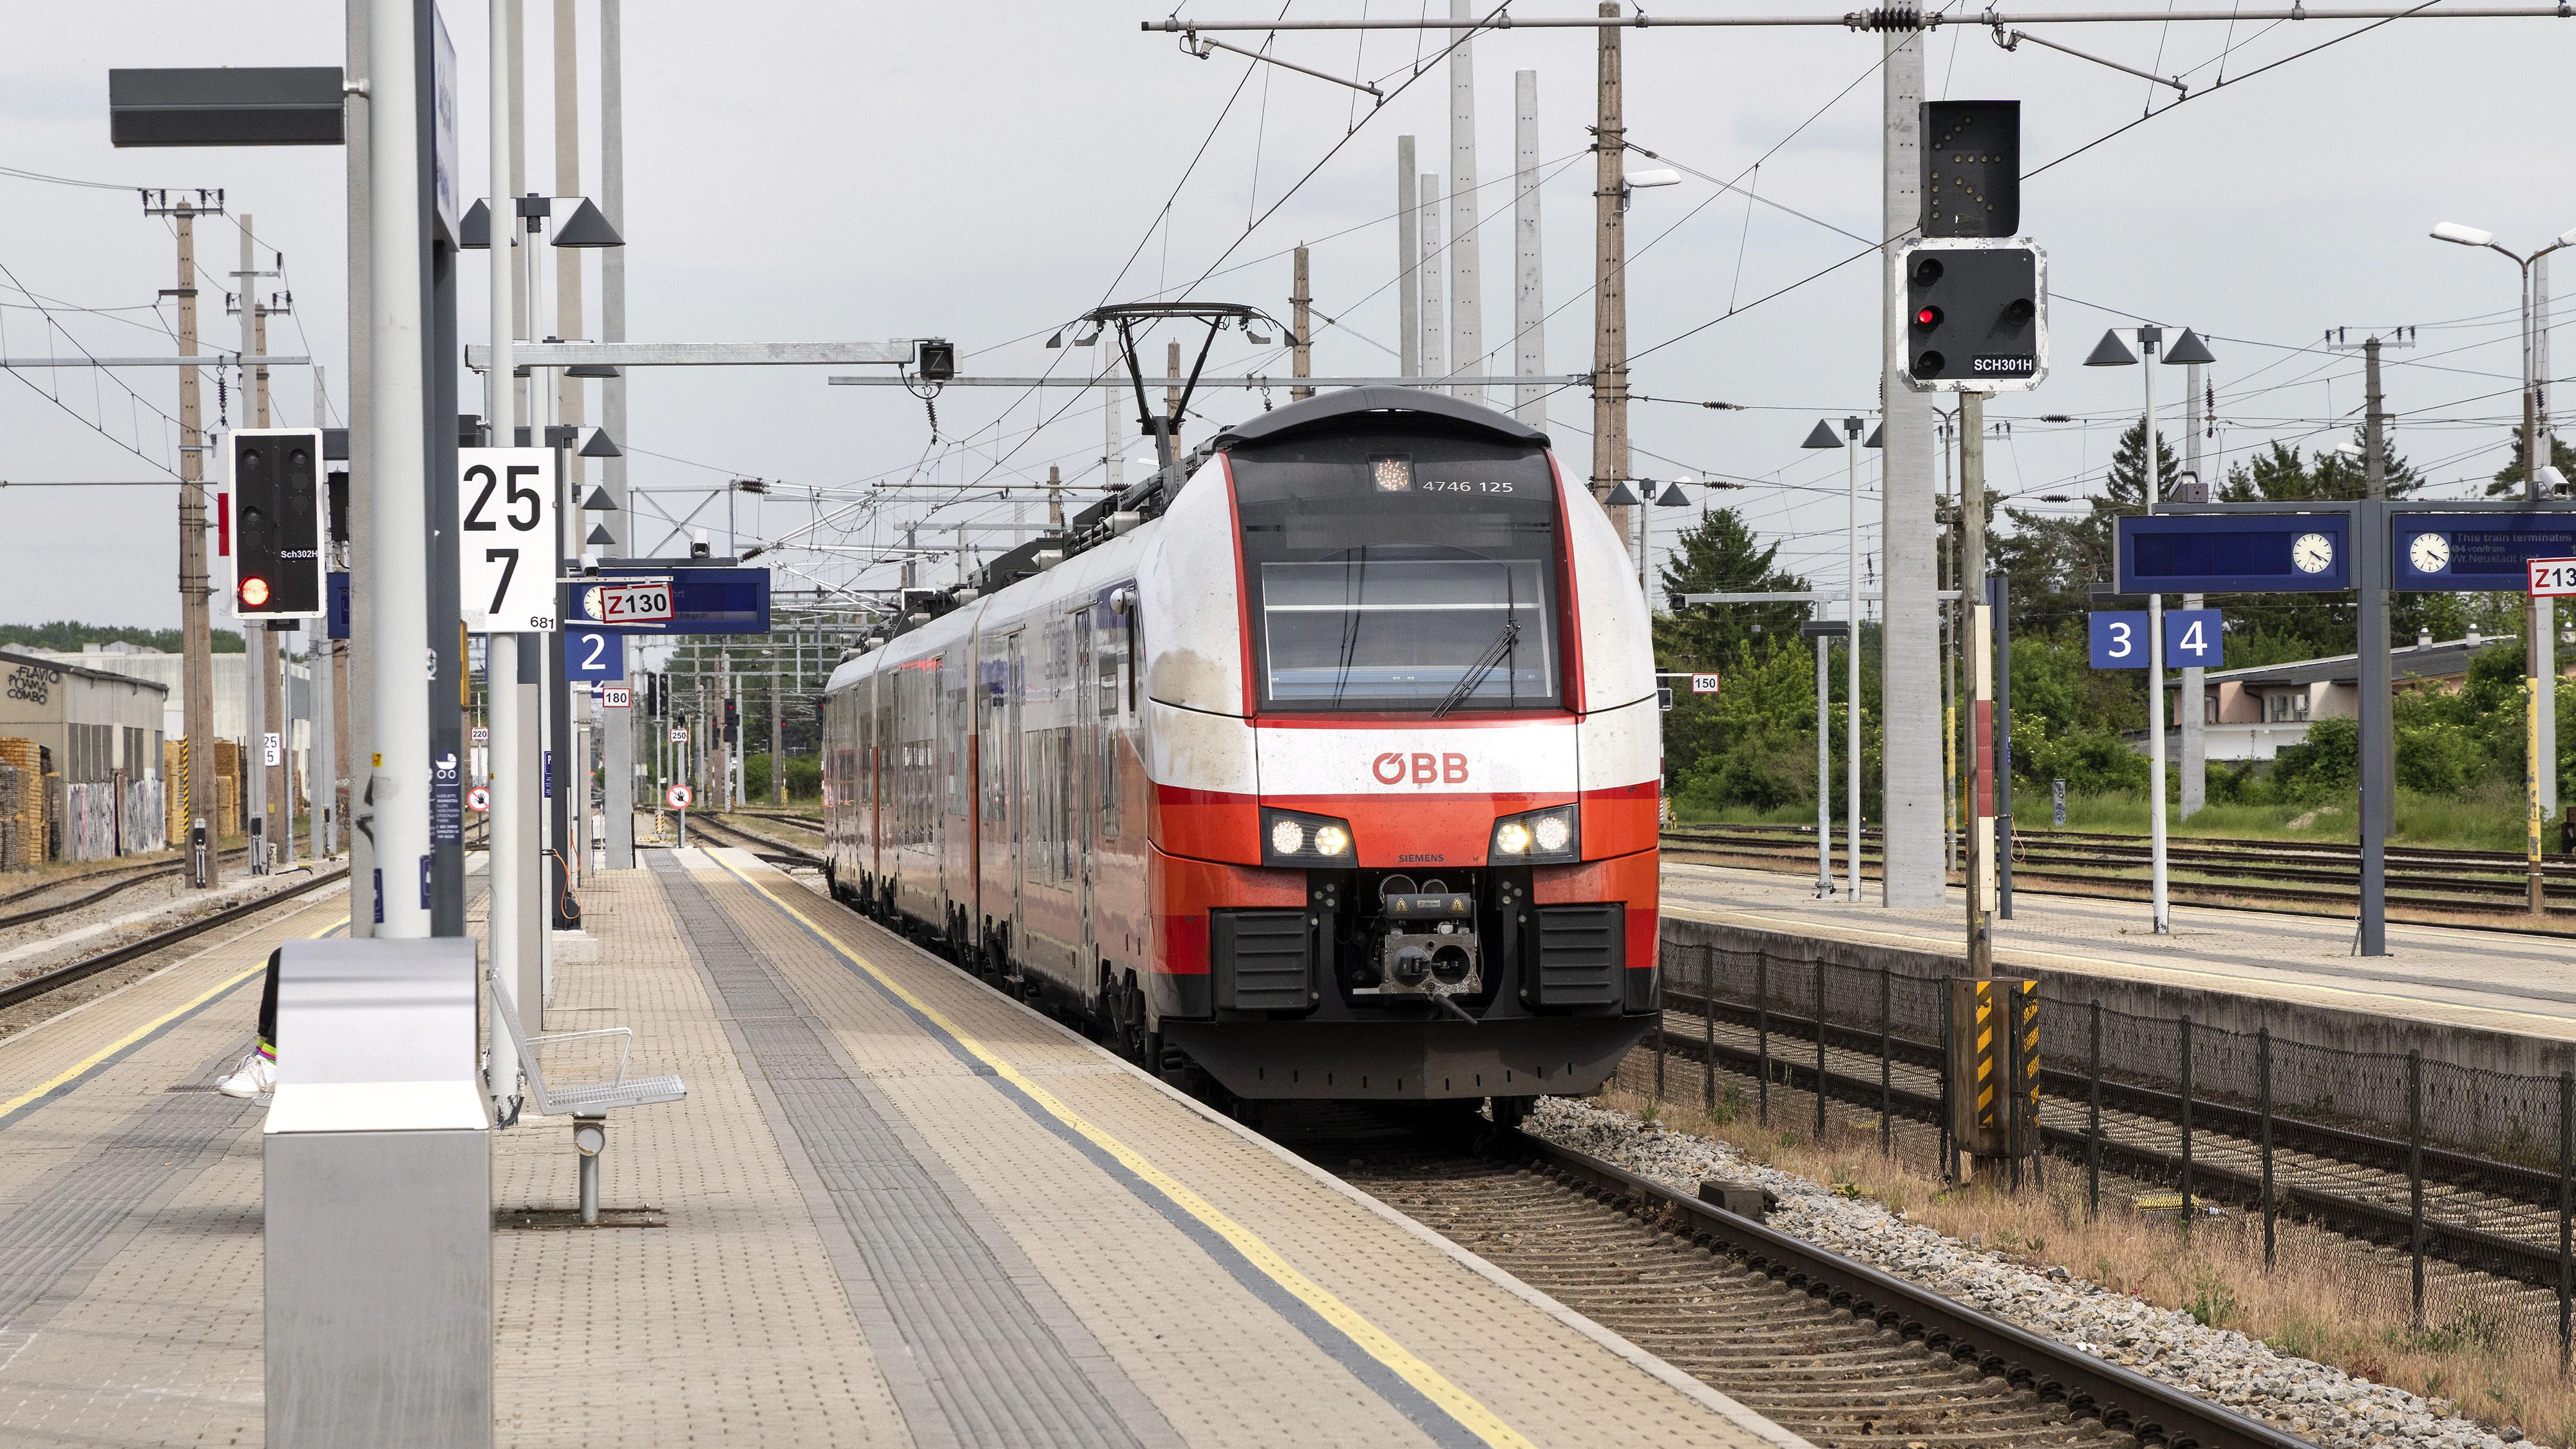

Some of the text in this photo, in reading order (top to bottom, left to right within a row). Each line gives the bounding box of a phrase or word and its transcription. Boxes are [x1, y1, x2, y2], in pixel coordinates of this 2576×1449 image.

[1974, 359, 2032, 371] SCH301H
[1423, 481, 1513, 493] 4746 125
[463, 464, 541, 532] 25
[2457, 533, 2572, 542] This train terminates
[280, 549, 318, 558] Sch302H
[486, 548, 519, 614] 7
[608, 593, 667, 614] Z130
[530, 616, 554, 630] 681
[2108, 621, 2132, 658] 3
[2180, 620, 2208, 656] 4
[581, 633, 606, 670] 2
[15, 665, 61, 685] FLAVIO
[1695, 678, 1716, 688] 150
[7, 688, 48, 705] COMBO
[606, 692, 627, 703] 180
[264, 736, 277, 748] 25
[267, 750, 274, 762] 5
[1372, 752, 1469, 785] ÖBB
[1398, 853, 1444, 863] SIEMENS
